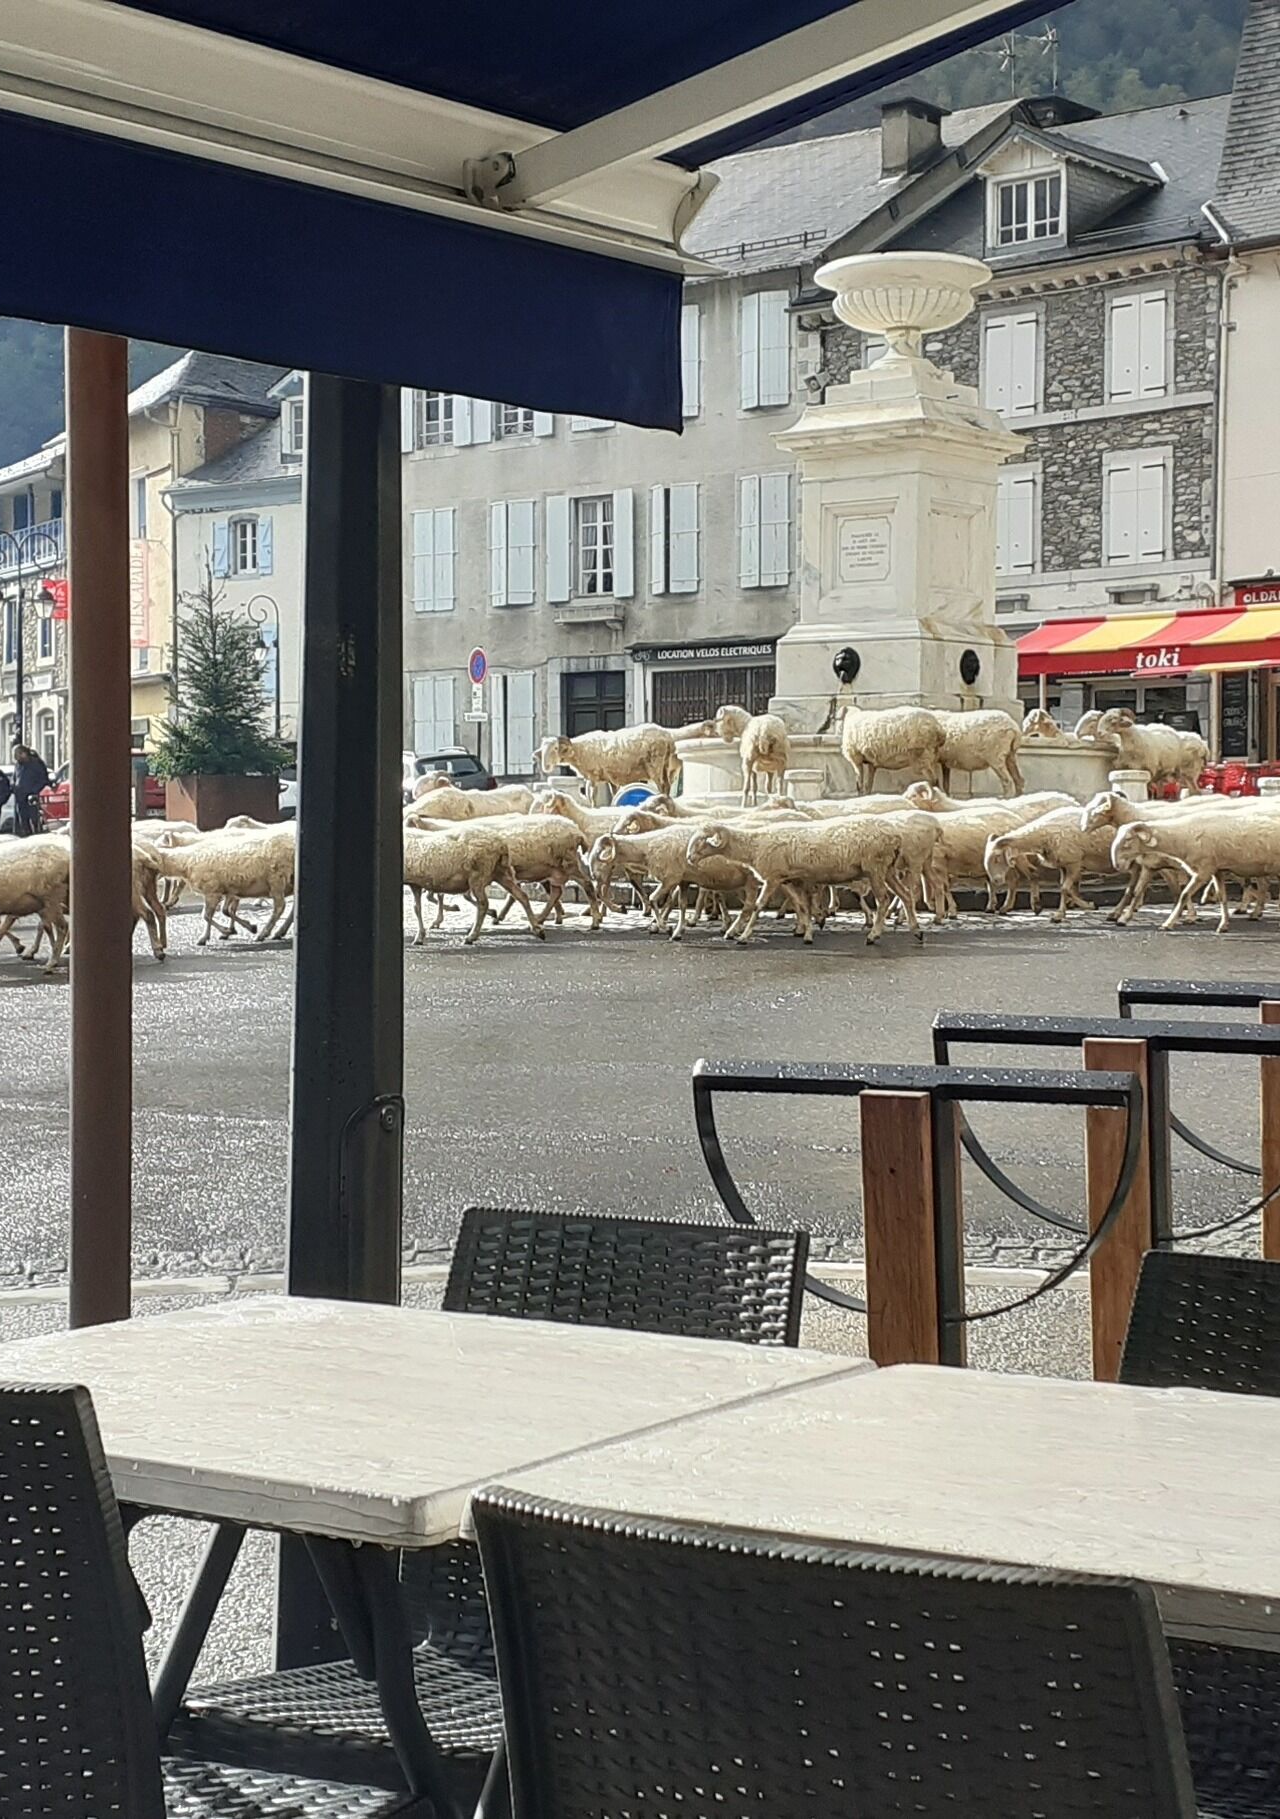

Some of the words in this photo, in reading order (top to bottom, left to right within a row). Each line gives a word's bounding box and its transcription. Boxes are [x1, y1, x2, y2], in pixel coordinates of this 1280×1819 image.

[657, 649, 694, 660] LOCATION
[695, 647, 719, 658] VELOS
[720, 644, 772, 657] ELECTRIQUES
[1135, 647, 1181, 668] toki
